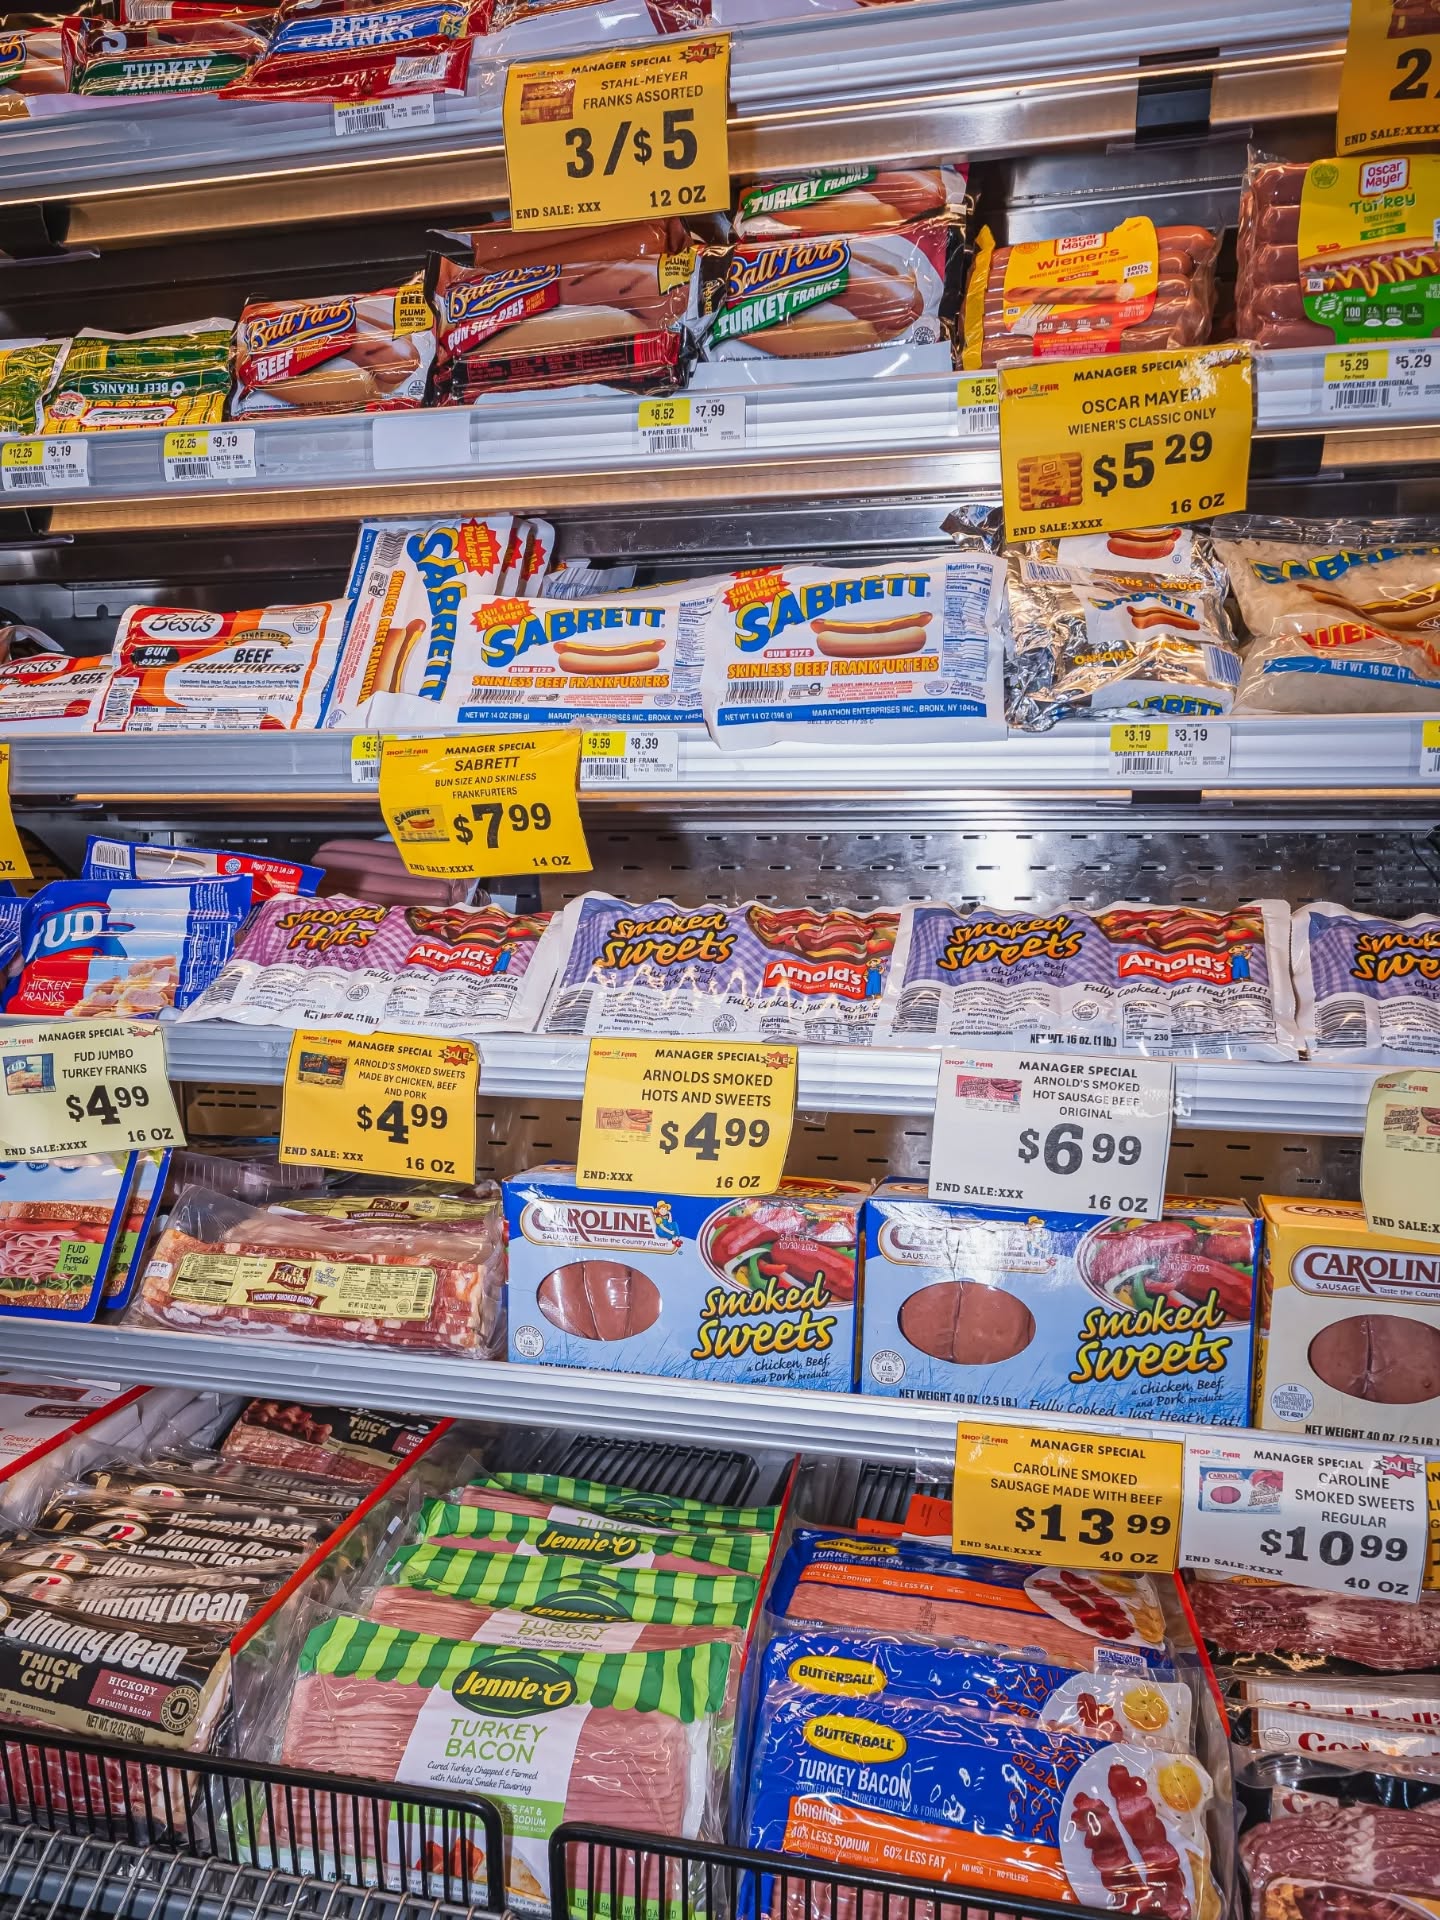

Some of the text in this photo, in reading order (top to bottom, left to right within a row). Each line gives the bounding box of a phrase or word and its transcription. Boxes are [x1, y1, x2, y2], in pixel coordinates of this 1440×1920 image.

[329, 16, 402, 35] BEEF
[600, 71, 688, 90] STAHL-MEYER
[583, 85, 703, 110] FRANKS ASSORTED
[1368, 162, 1402, 177] Oscar
[1366, 173, 1402, 189] Mayer
[650, 185, 706, 208] 12 OZ
[751, 180, 821, 214] TURKEY
[1350, 193, 1415, 214] Turkey
[516, 209, 539, 220] END
[729, 240, 846, 296] Ball Park
[1037, 249, 1120, 270] Wieners
[1064, 272, 1094, 281] CLASSIC
[400, 309, 426, 317] PLUMP
[718, 279, 840, 337] TURKEY FRANKS
[257, 350, 294, 381] BEEF
[1396, 354, 1431, 369] $5.29
[1073, 365, 1138, 382] MANAGER
[1006, 383, 1060, 397] SHOP FAIR
[651, 408, 674, 420] $8.52
[696, 404, 725, 417] $7.99
[1082, 396, 1140, 415] OSCAR
[683, 426, 708, 434] FRANKS
[1068, 408, 1216, 436] WIENER'S CLASSIC ONLY
[172, 438, 197, 449] $12.25
[213, 435, 238, 448] $9.19
[947, 564, 975, 572] Nutrition
[406, 527, 467, 703] SABRETT
[734, 573, 931, 652] SABRETT
[149, 614, 215, 633] Best's
[481, 607, 665, 668] SABRETT
[234, 649, 272, 663] BEEF
[727, 657, 939, 679] SKINLESS BEEF FRANKFURTERS
[1331, 660, 1349, 670] NET
[1369, 665, 1380, 675] 16
[812, 706, 900, 717] MARATHON ENTERPRISES
[588, 737, 611, 750] $9.59
[631, 737, 659, 750] $8.39
[1175, 729, 1208, 742] $3.19
[445, 741, 536, 755] MANAGER SPECIAL
[453, 756, 520, 772] SABRETT
[435, 773, 537, 787] BUN SIZE AND SKINLESS
[452, 787, 518, 799] FRANKFURTERS
[532, 856, 571, 867] 14 OZ
[1122, 953, 1226, 974] Arnold's
[768, 963, 862, 986] Arnold's
[1192, 967, 1227, 980] MEATS
[74, 1049, 134, 1062] FUD JUMBO
[62, 1064, 147, 1079] TURKEY FRANKS
[354, 1058, 466, 1079] ARNOLD'S SMOKED SWEETS
[1019, 1061, 1138, 1078] MANAGER SPECIAL
[358, 1071, 457, 1091] MADE CHICKEN, BEEF
[643, 1069, 773, 1087] ARNOLDS SMOKED
[1034, 1076, 1140, 1092] ARNOLD'S SMOKED
[404, 1090, 427, 1100] PORK
[641, 1089, 771, 1107] HOTS AND SWEETS
[1033, 1090, 1109, 1104] HOT SAUSAGE
[1059, 1106, 1113, 1120] ORIGINAL
[1089, 1194, 1148, 1213] 16 OZ
[1372, 1215, 1395, 1228] END
[67, 1245, 86, 1254] FUD
[64, 1254, 89, 1265] Fresh
[1316, 1283, 1360, 1292] SAUSAGE
[900, 1389, 965, 1402] NET WEIGHT 40
[1031, 1438, 1146, 1459] MANAGER SPECIAL
[1014, 1463, 1137, 1486] CAROLINE SMOKED
[1318, 1472, 1390, 1489] CAROLINE
[991, 1478, 1163, 1505] SAUSAGE MADE WITH BEEF
[1295, 1489, 1415, 1512] SMOKED SWEETS
[1321, 1511, 1386, 1528] REGULAR
[1100, 1551, 1159, 1564] 40 OZ
[4, 1610, 188, 1680] Jimmy Dean
[18, 1650, 83, 1680] THICK
[21, 1669, 65, 1694] CUT
[108, 1676, 158, 1696] HICKORY
[96, 1697, 152, 1717] PREMIUM BACON
[86, 1714, 98, 1728] NET
[451, 1719, 548, 1743] TURKEY
[814, 1725, 895, 1752] BUTTERBALL
[445, 1738, 535, 1764] BACON
[427, 1761, 538, 1780] Cured Turkey Chopped Formed
[798, 1758, 912, 1800] TURKEY BACON
[447, 1775, 497, 1789] Natural Smoke
[513, 1815, 546, 1826] SODIUM
[883, 1845, 902, 1860] 60%
[904, 1850, 927, 1865] LESS
[928, 1854, 946, 1868] FAT
